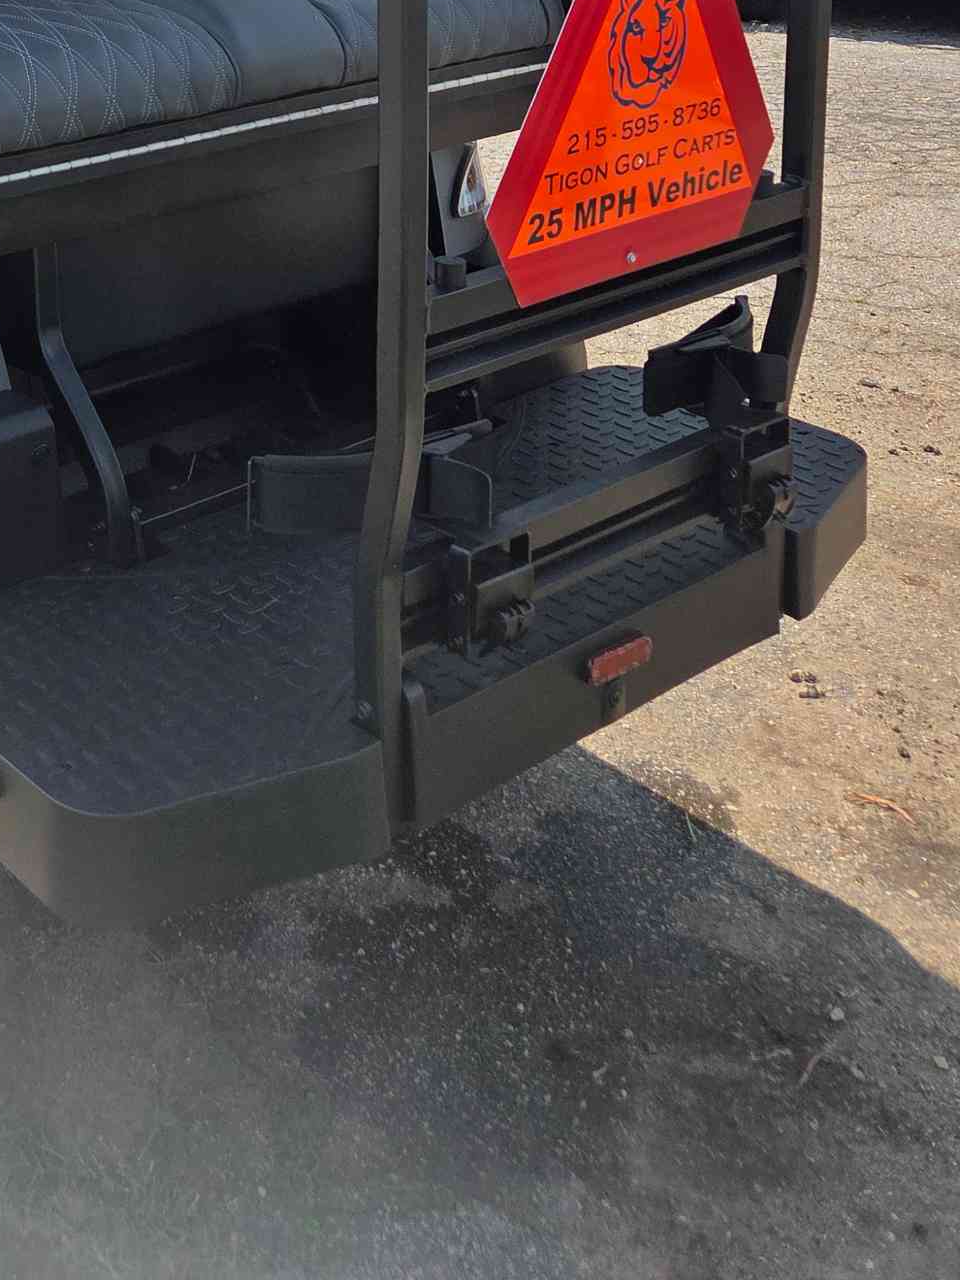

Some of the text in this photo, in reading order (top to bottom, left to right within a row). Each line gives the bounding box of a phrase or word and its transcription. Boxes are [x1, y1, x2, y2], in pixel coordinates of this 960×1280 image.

[544, 128, 736, 195] TIGON GOLF CARTS
[526, 159, 744, 246] 25 MPH Vehicle
